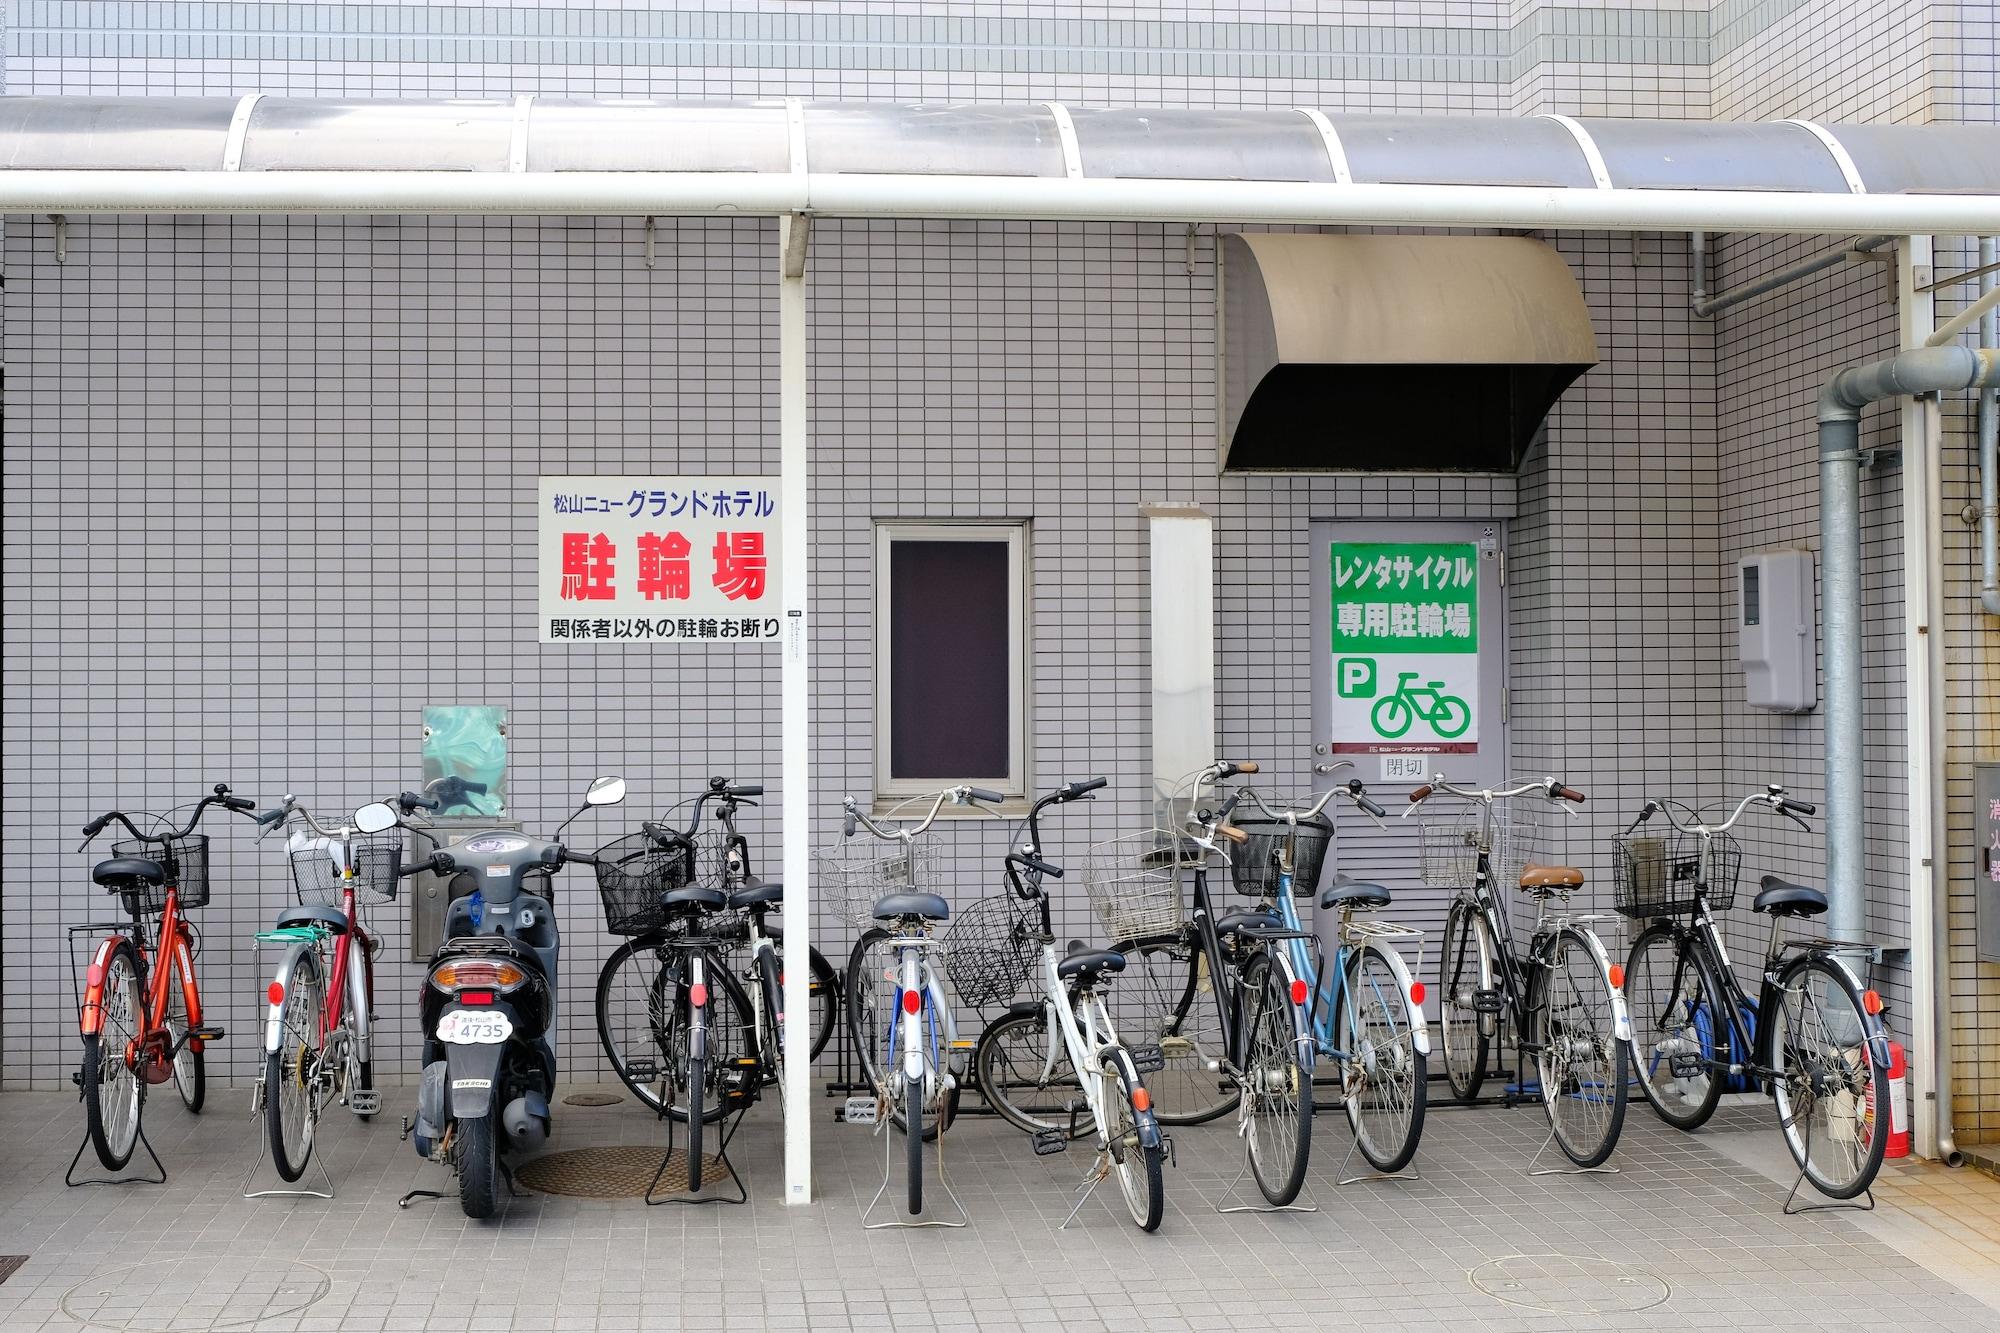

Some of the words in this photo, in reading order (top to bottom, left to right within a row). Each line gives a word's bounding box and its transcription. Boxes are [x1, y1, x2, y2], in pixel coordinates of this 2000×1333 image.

[554, 490, 774, 518] 松山ニューグランドホテル
[560, 531, 767, 601] 駐輪場
[1335, 556, 1473, 590] レンタサイクル
[551, 618, 780, 640] 関係者以外の駐輪お断り
[1336, 602, 1471, 637] 専用駐輪場
[1386, 758, 1423, 777] 閉切
[461, 1024, 503, 1038] 4735
